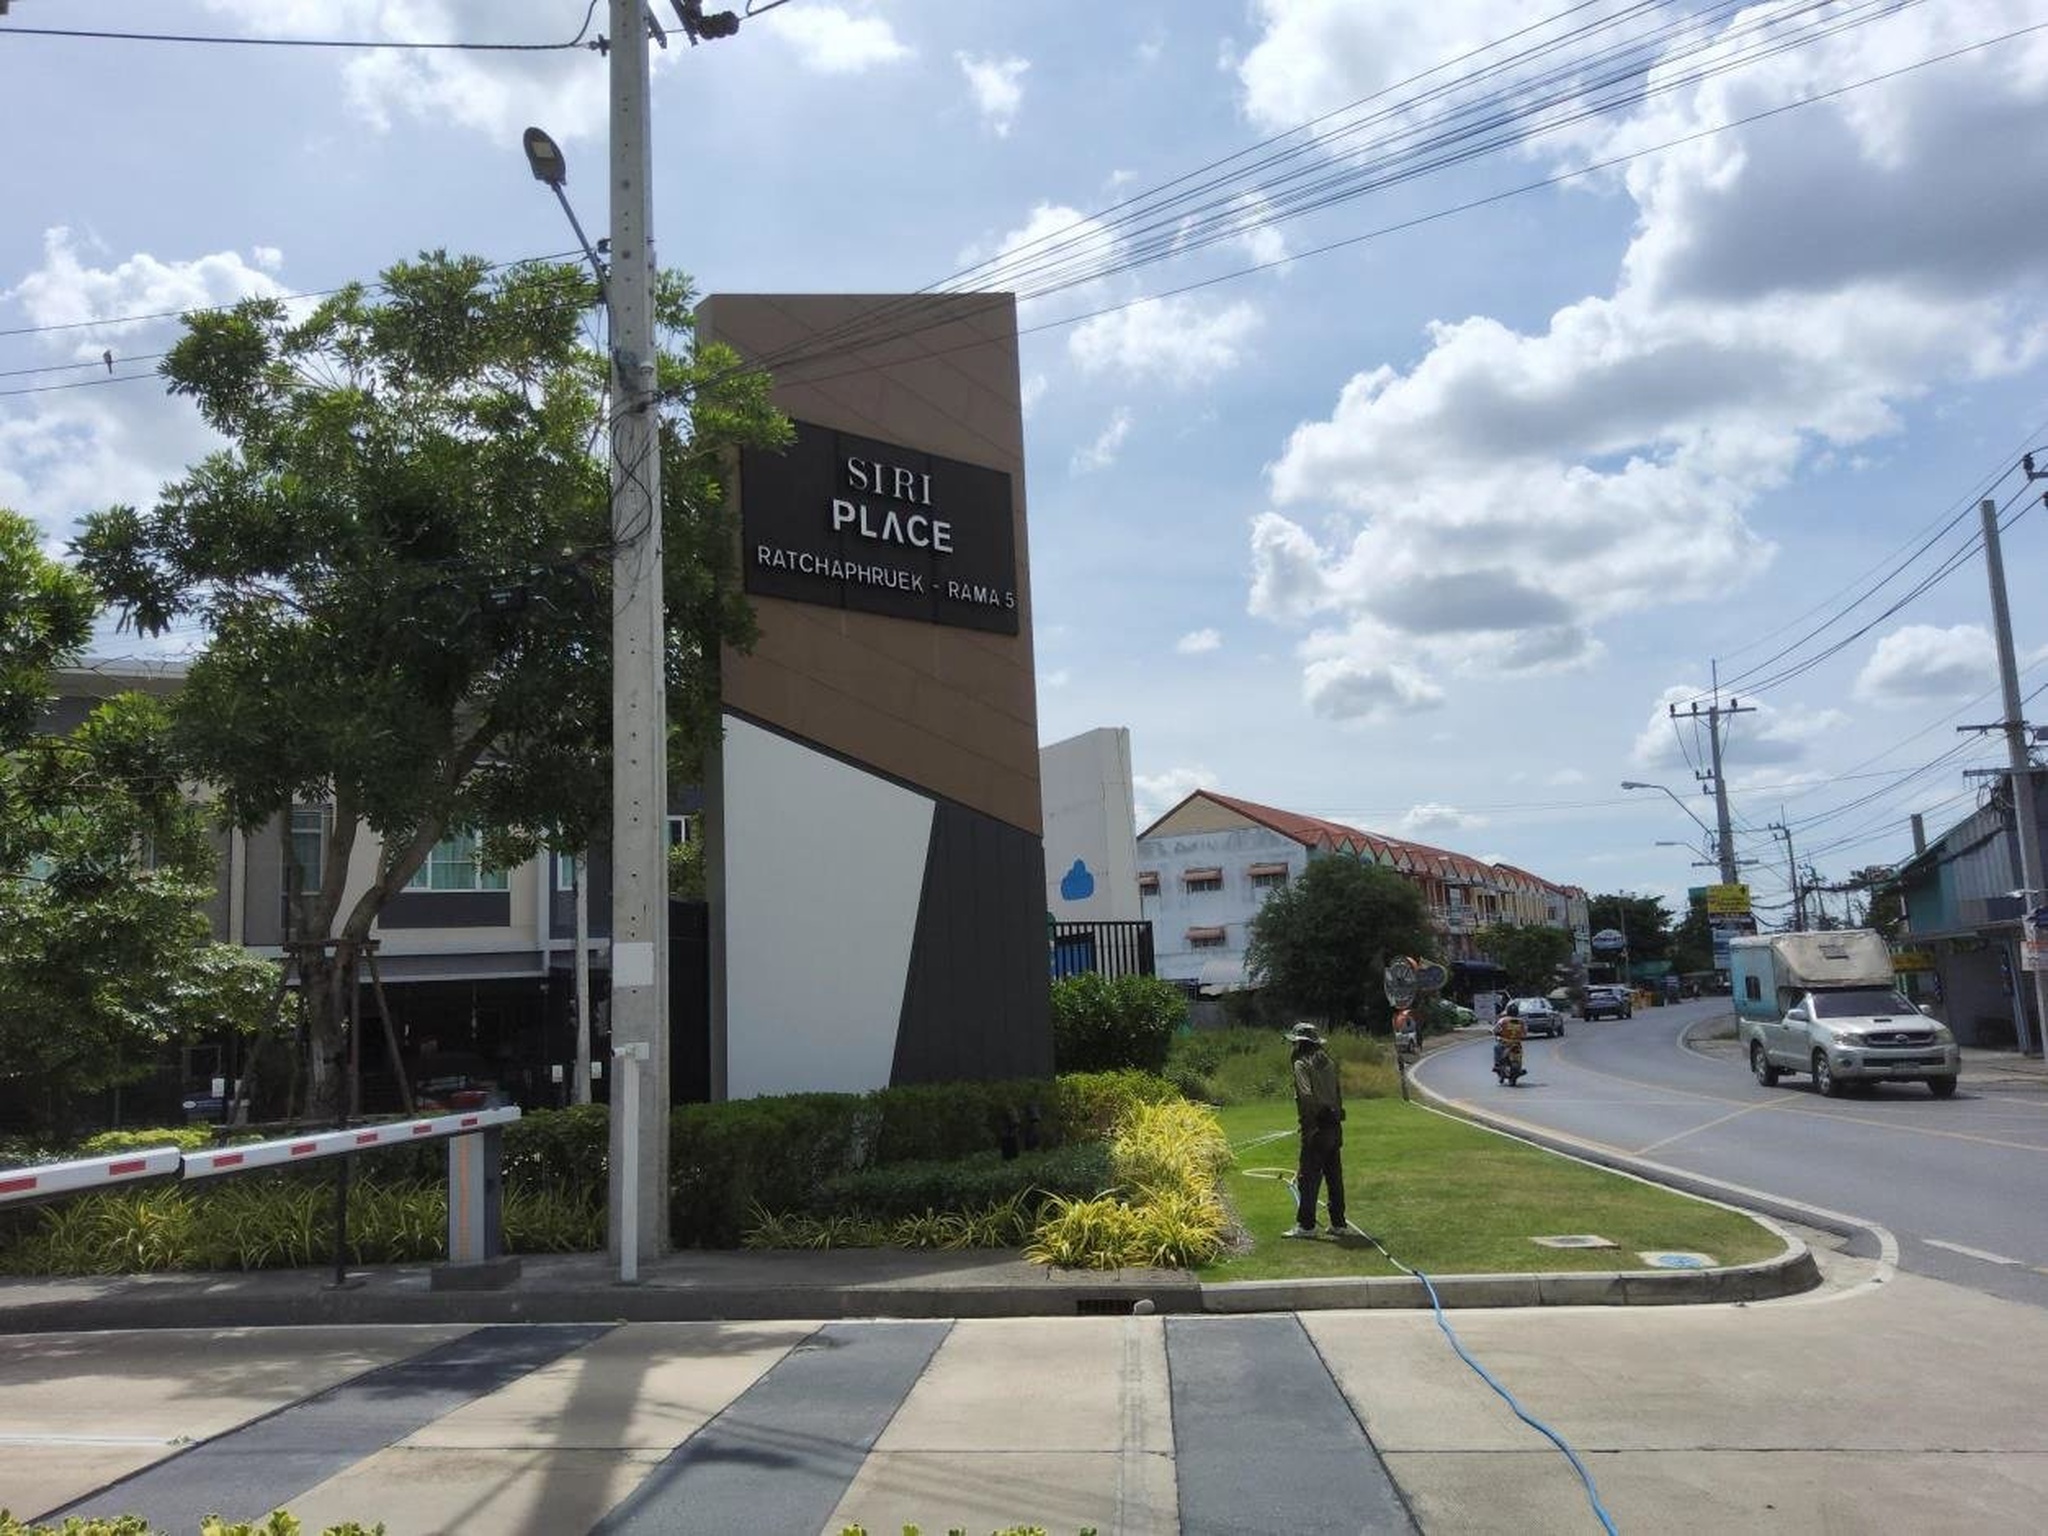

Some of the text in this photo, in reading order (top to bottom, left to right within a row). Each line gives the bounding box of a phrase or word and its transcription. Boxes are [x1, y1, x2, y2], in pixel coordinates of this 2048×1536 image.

[848, 456, 931, 506] SIRI
[832, 499, 953, 553] PLACE
[757, 545, 924, 593] RATCHAPHRUEK
[949, 580, 1000, 606] RAMA
[1005, 592, 1015, 609] 5
